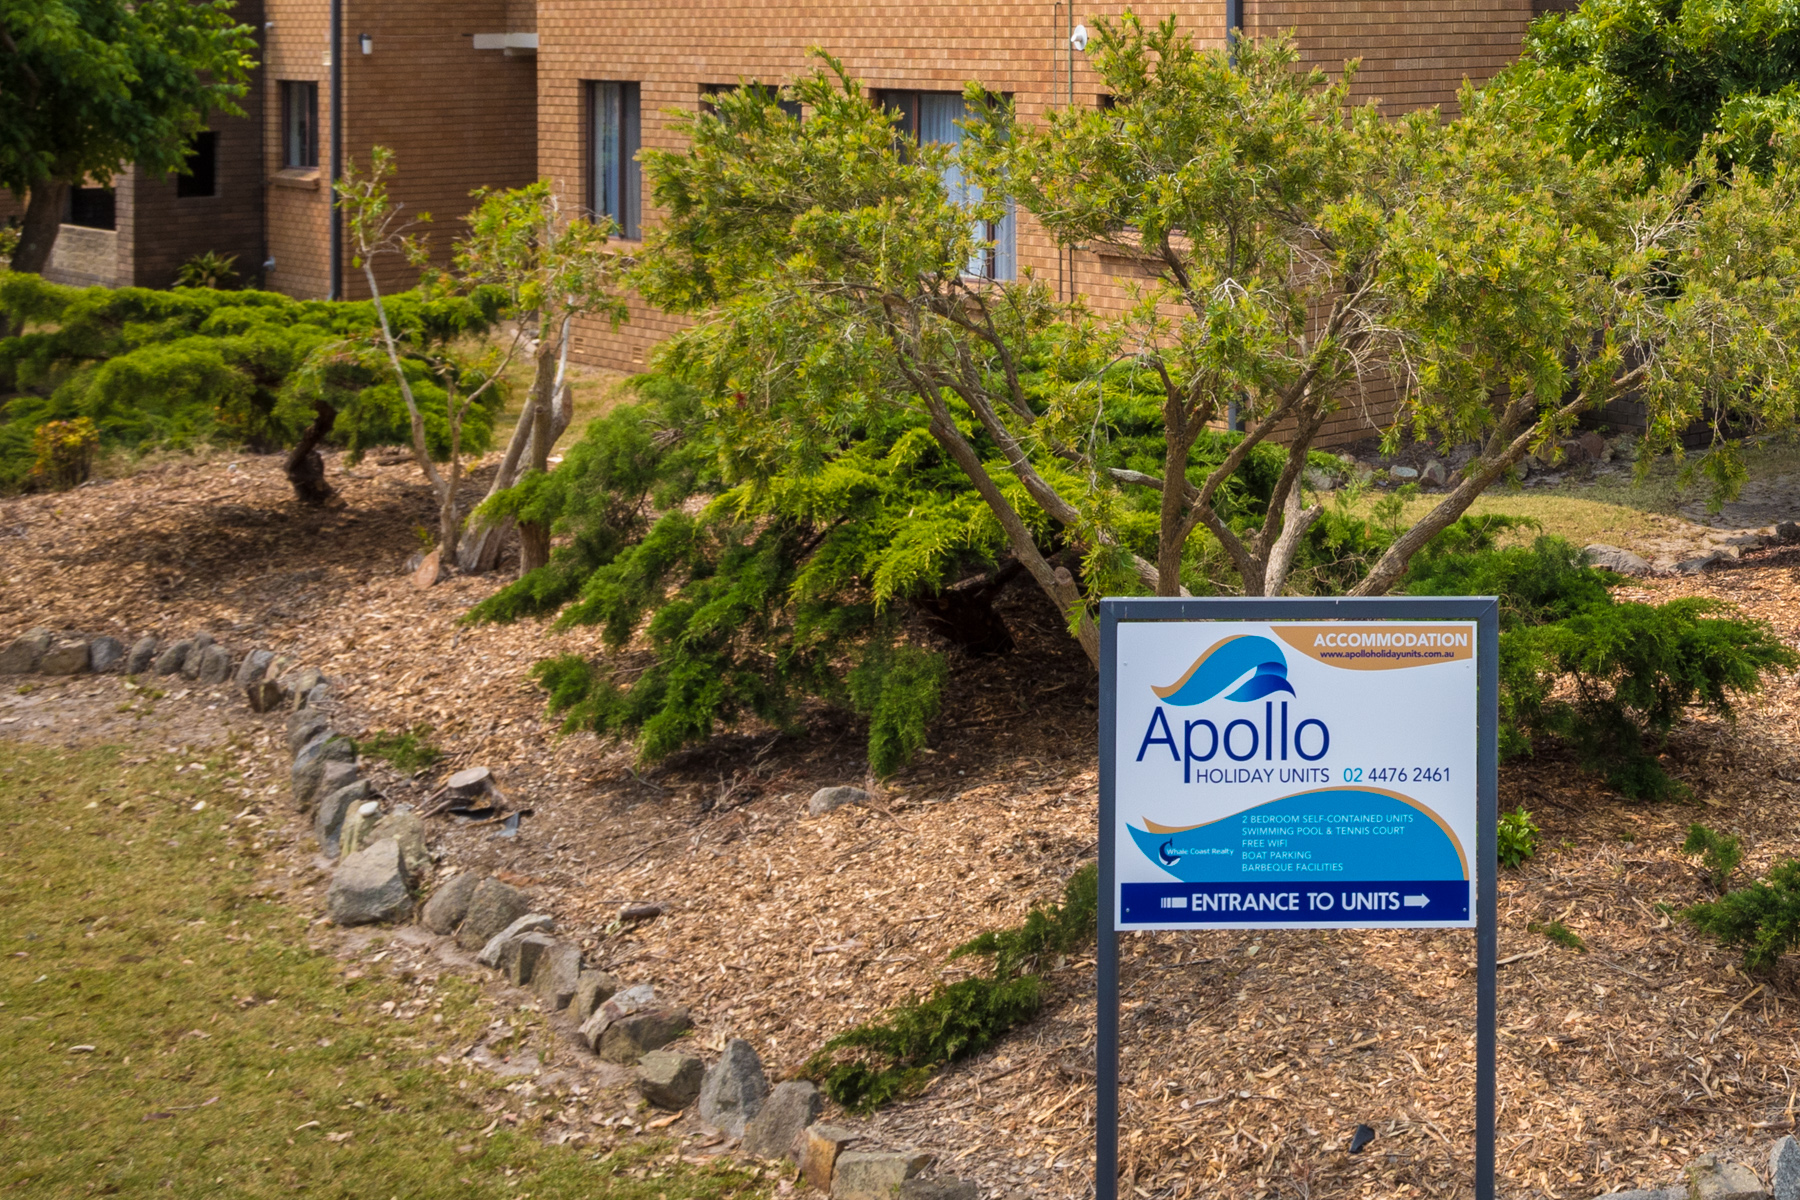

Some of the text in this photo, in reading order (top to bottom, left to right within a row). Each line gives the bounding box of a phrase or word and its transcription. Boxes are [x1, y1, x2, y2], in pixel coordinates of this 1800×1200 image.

[1313, 633, 1468, 647] ACCOMMODATION
[1320, 650, 1455, 660] www.apolloholidayunits.com.au
[1135, 701, 1330, 784] Apollo
[1196, 767, 1450, 784] HOLIDAY UNITS 02 4476 2461
[1241, 814, 1414, 824] 2 BEDROOM SELF-CONTAINED UNITS
[1242, 826, 1405, 836] SWIMMING POOL & TENNIS COURT
[1242, 839, 1288, 848] FREE WIFI
[1211, 848, 1234, 856] Realty
[1242, 851, 1312, 860] BOAT PARKING
[1242, 863, 1343, 872] BARBEQUE FACILITIES
[1192, 892, 1400, 911] ENTRANCE TO UNITS
